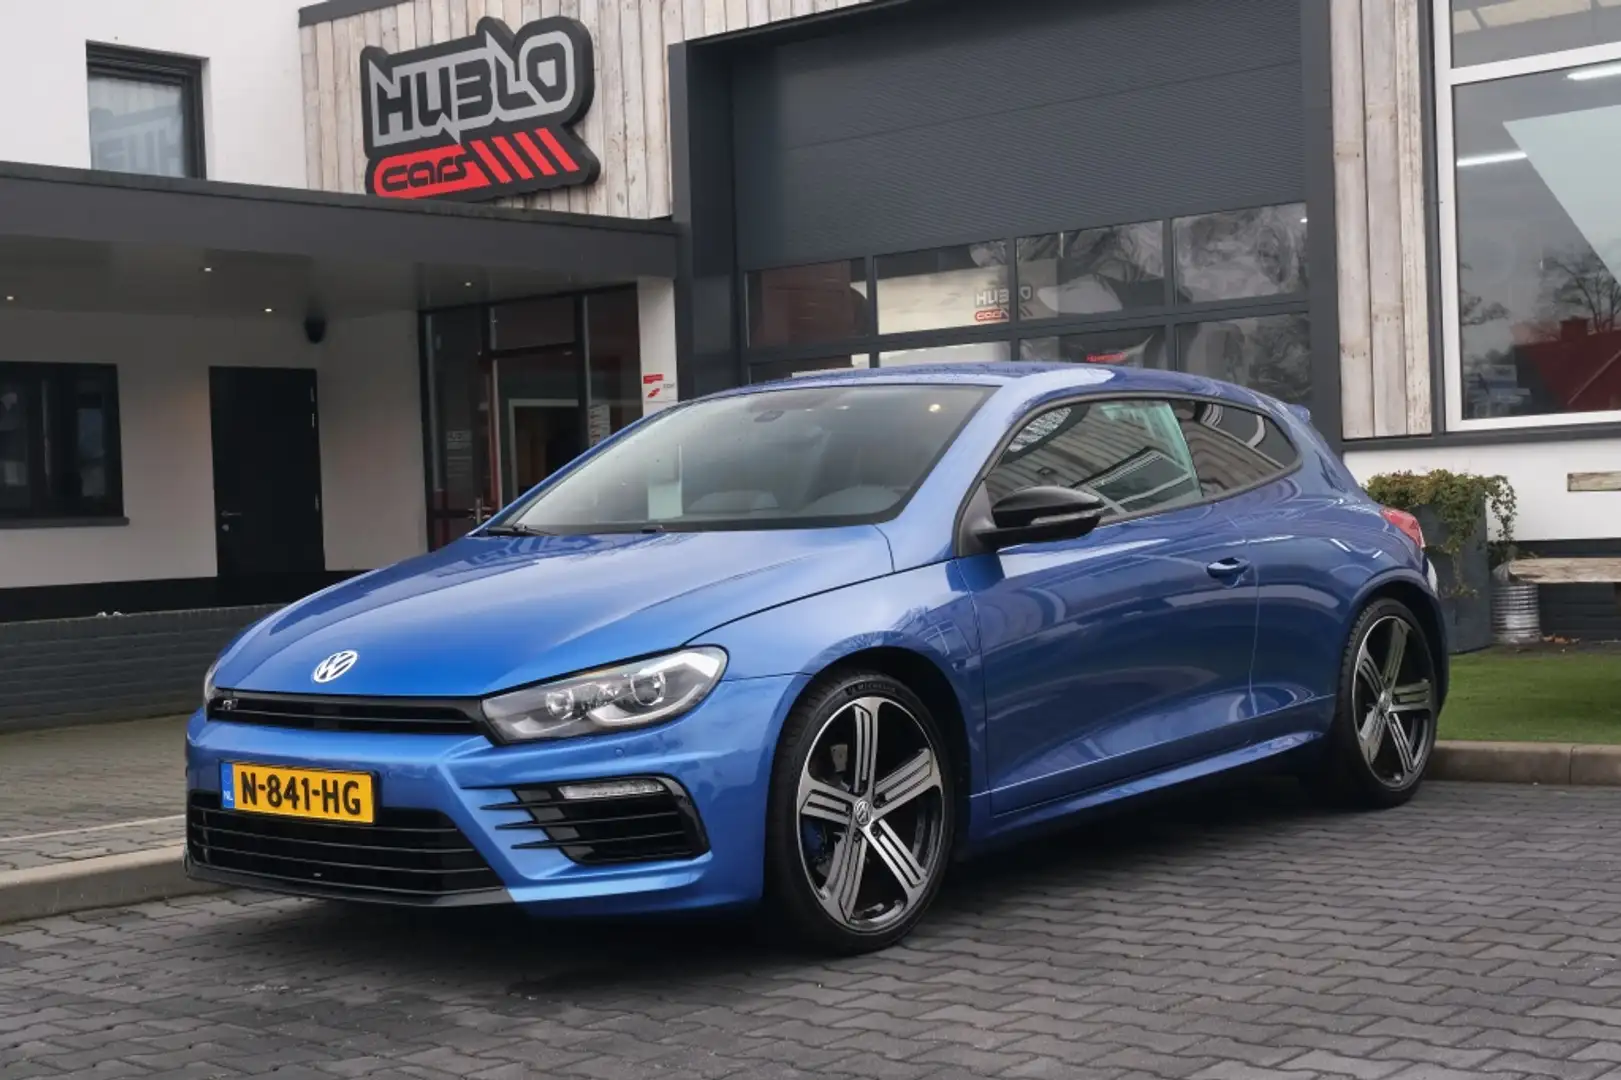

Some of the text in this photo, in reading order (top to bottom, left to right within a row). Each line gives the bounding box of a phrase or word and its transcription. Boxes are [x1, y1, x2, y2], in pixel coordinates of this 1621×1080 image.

[368, 32, 574, 148] HUBLO
[223, 790, 234, 801] NL
[240, 771, 362, 816] N-841-HG
